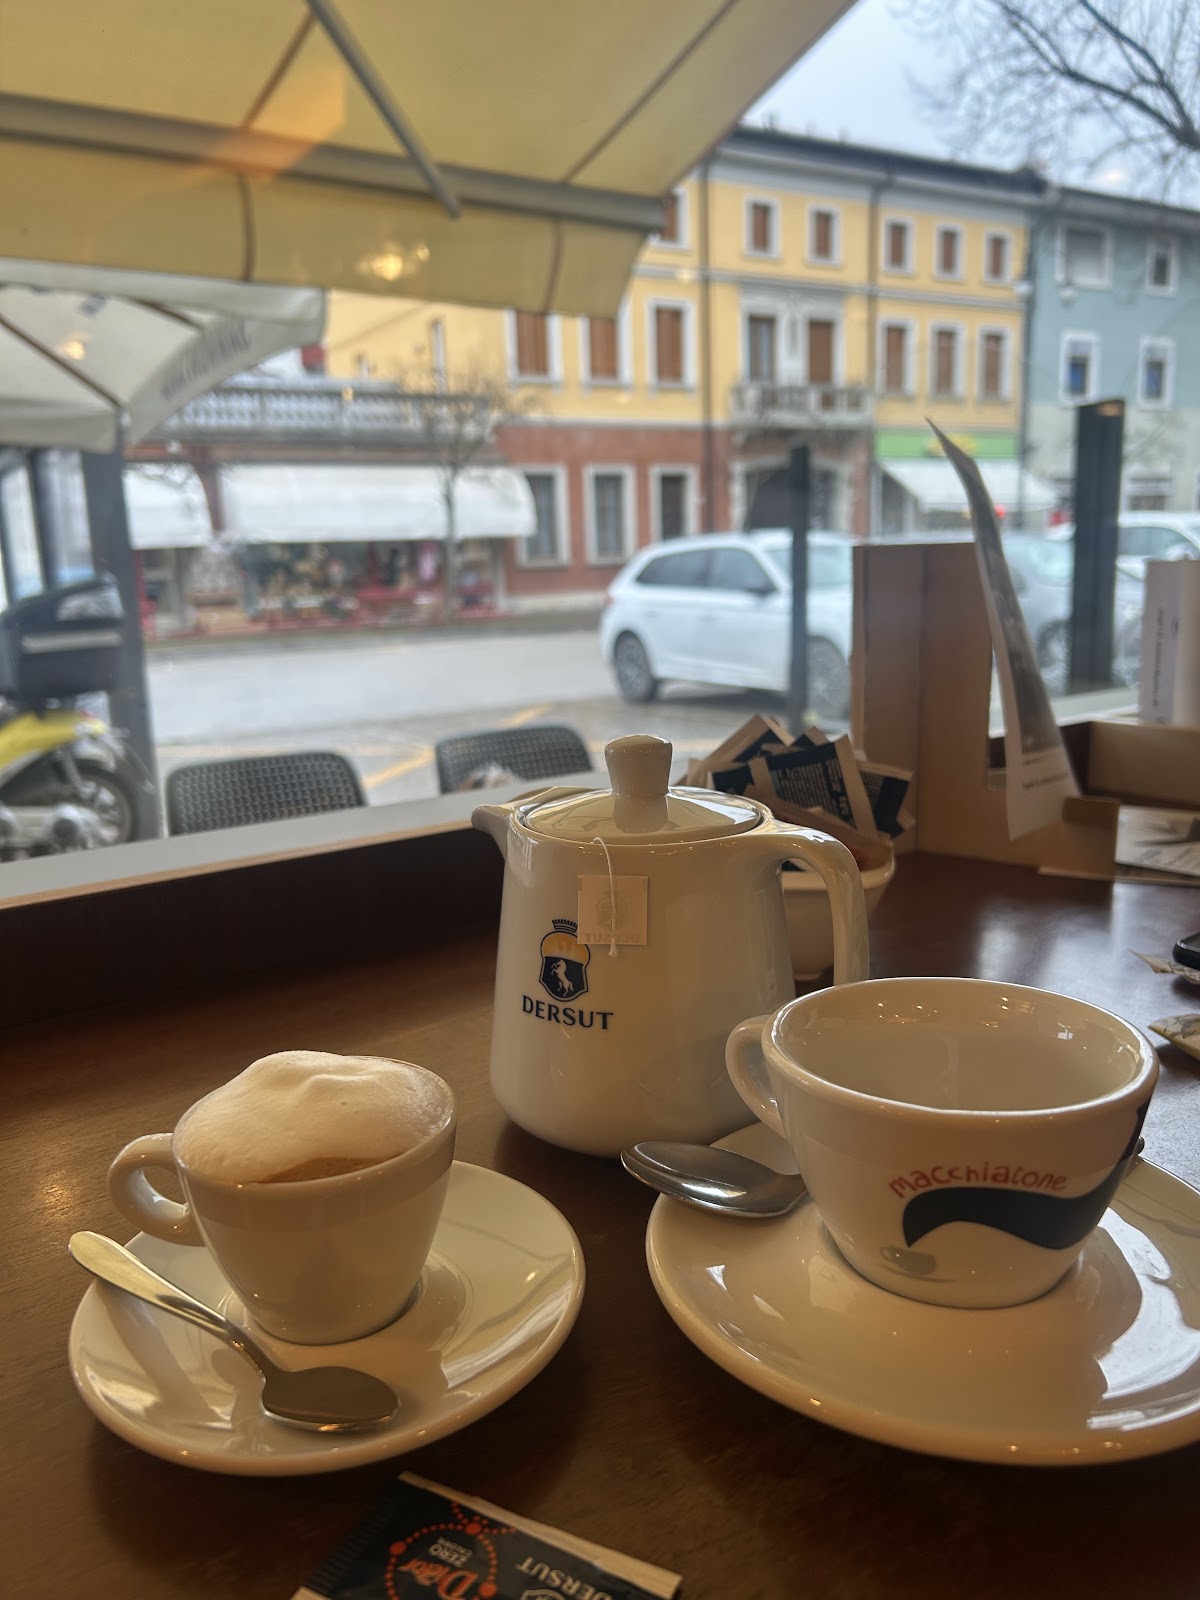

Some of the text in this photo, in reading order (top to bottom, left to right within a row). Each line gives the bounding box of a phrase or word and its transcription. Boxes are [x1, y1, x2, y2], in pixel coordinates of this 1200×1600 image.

[522, 994, 614, 1030] DERSUT
[888, 1161, 1067, 1199] macchiatone
[428, 1543, 469, 1568] ZERO
